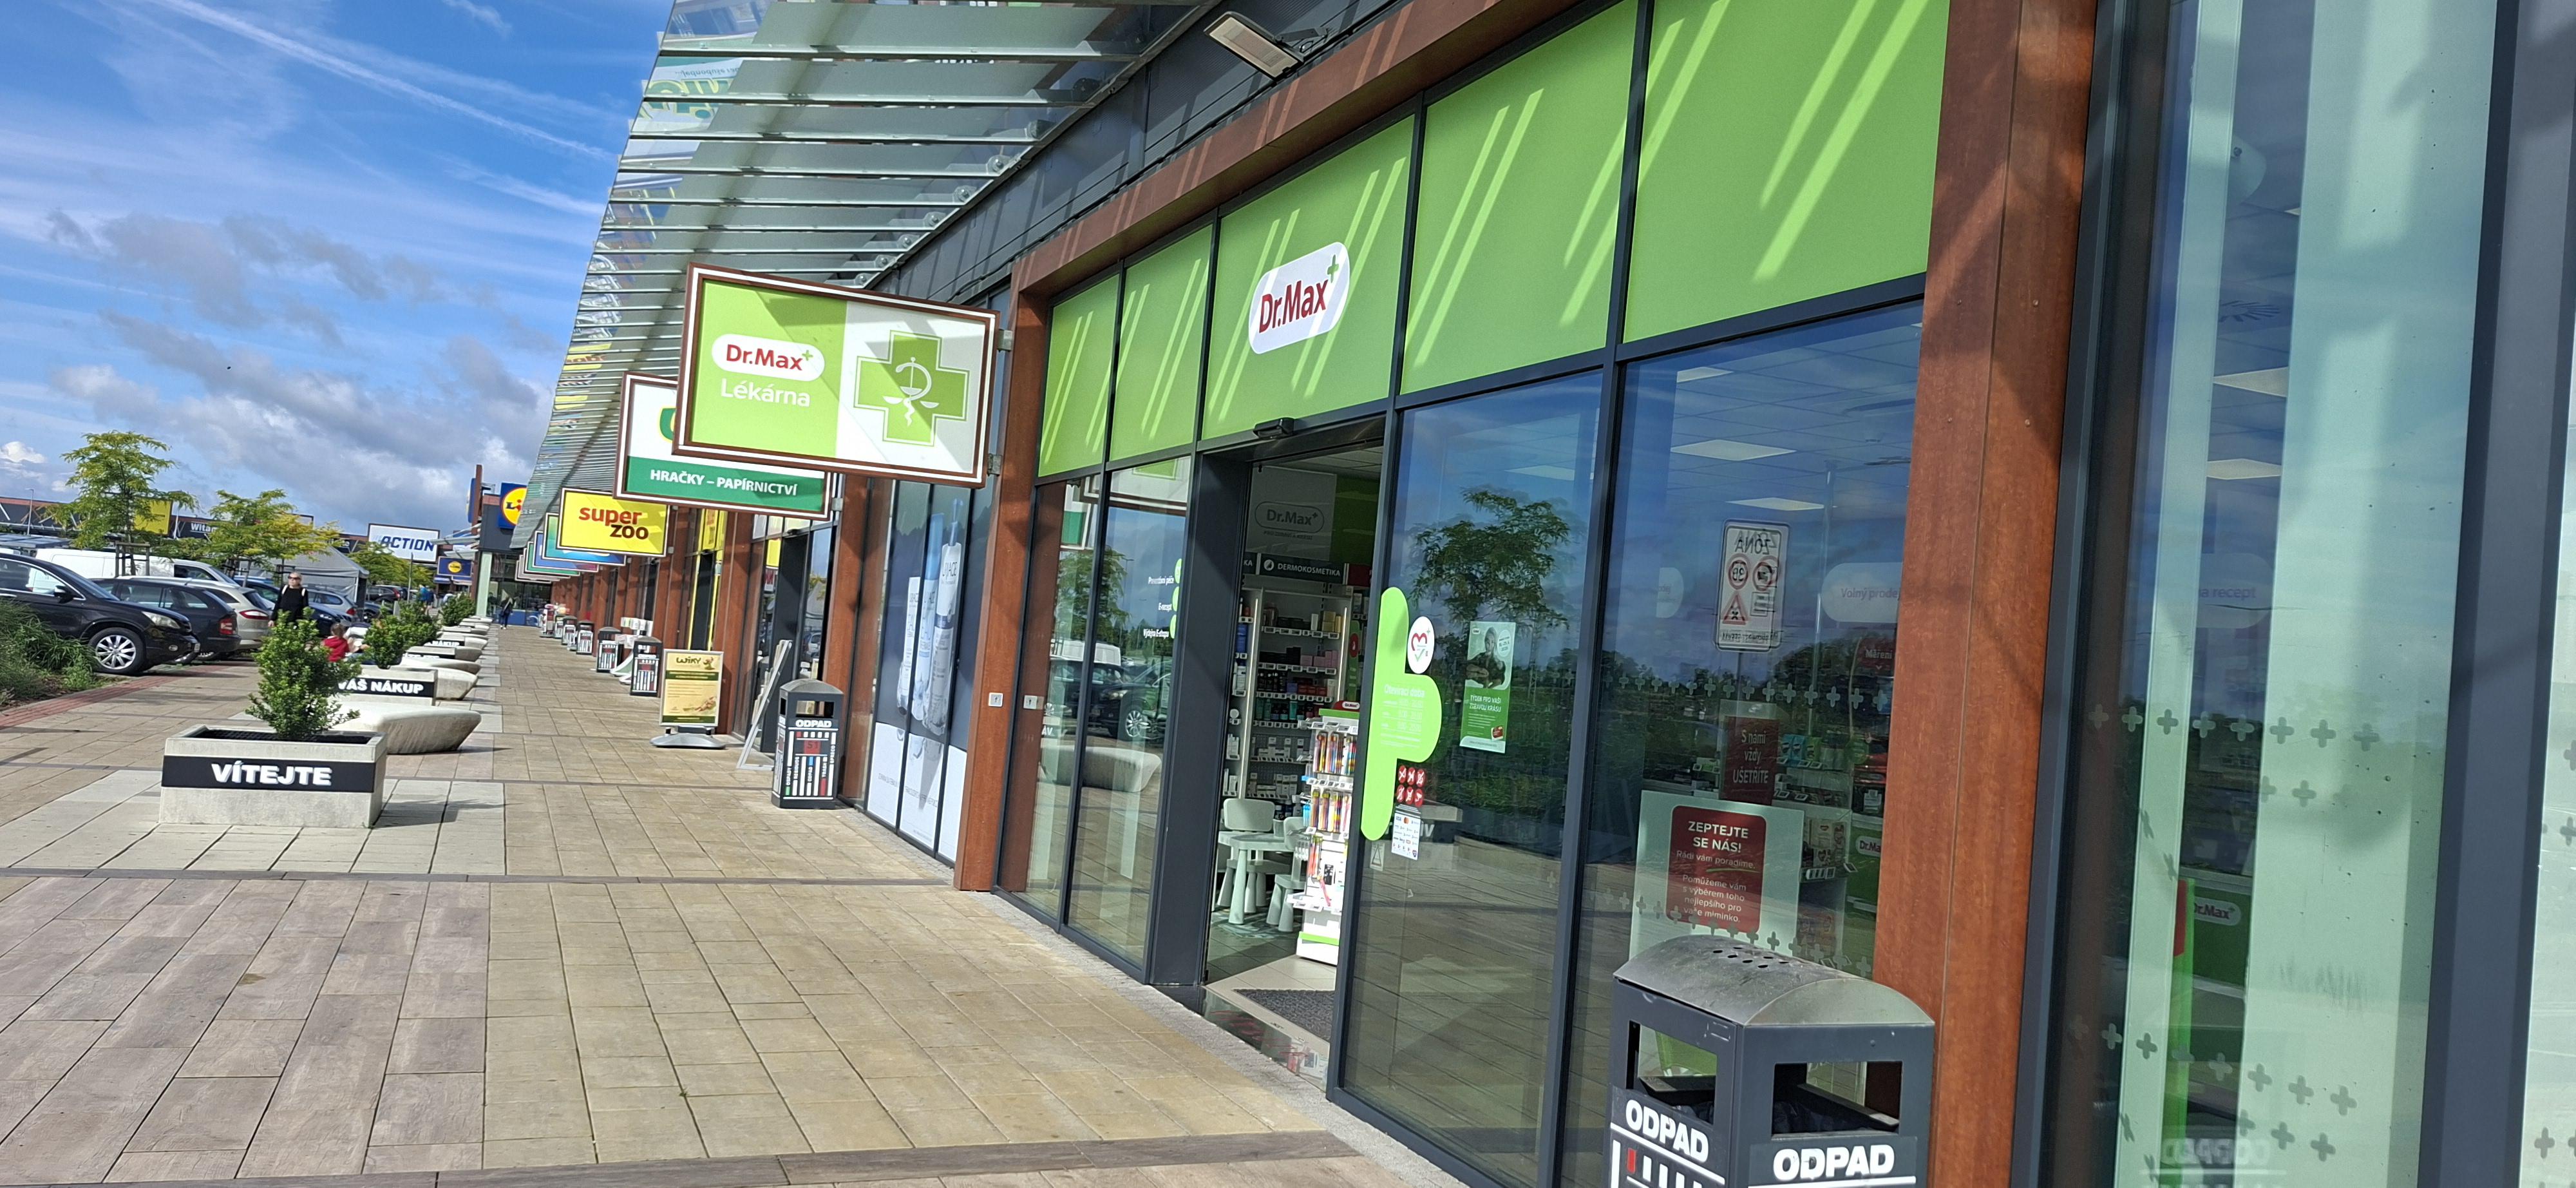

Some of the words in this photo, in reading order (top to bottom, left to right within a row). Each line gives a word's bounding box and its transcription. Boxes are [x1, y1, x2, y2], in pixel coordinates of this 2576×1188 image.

[1259, 279, 1329, 333] Dr.Max
[726, 344, 803, 370] Dr.Max
[721, 378, 810, 407] Lékárna
[650, 469, 705, 485] HRAČKY
[717, 477, 798, 495] PAPÍRNICTVÍ
[579, 507, 642, 526] super
[610, 524, 649, 539] zoo
[379, 535, 435, 551] ACTION
[1277, 563, 1341, 577] DERMOKOSMETIKA
[1841, 588, 1868, 601] Volný
[370, 680, 424, 694] NÁKUP
[795, 719, 832, 728] ODPAD
[211, 760, 332, 786] VÍTEJTE
[1732, 766, 1769, 784] UŠETŘÍTE
[1688, 821, 1749, 839] ZEPTEJTE
[1692, 837, 1709, 848] SE
[1712, 838, 1742, 853] NÁS!
[1859, 839, 1881, 853] Dr.Ma
[1676, 850, 1694, 859] Rádi
[1696, 853, 1712, 862] vám
[1715, 857, 1756, 869] poradíme.
[1683, 874, 1727, 888] Pomůžeme
[1729, 881, 1747, 891] vám
[1689, 886, 1724, 899] výběrem
[1726, 892, 1745, 902] toho
[1684, 896, 1726, 910] nejlepšího
[1728, 903, 1742, 912] pro
[1625, 1099, 1710, 1164] ODPAD
[1773, 1144, 1895, 1182] ODPAD
